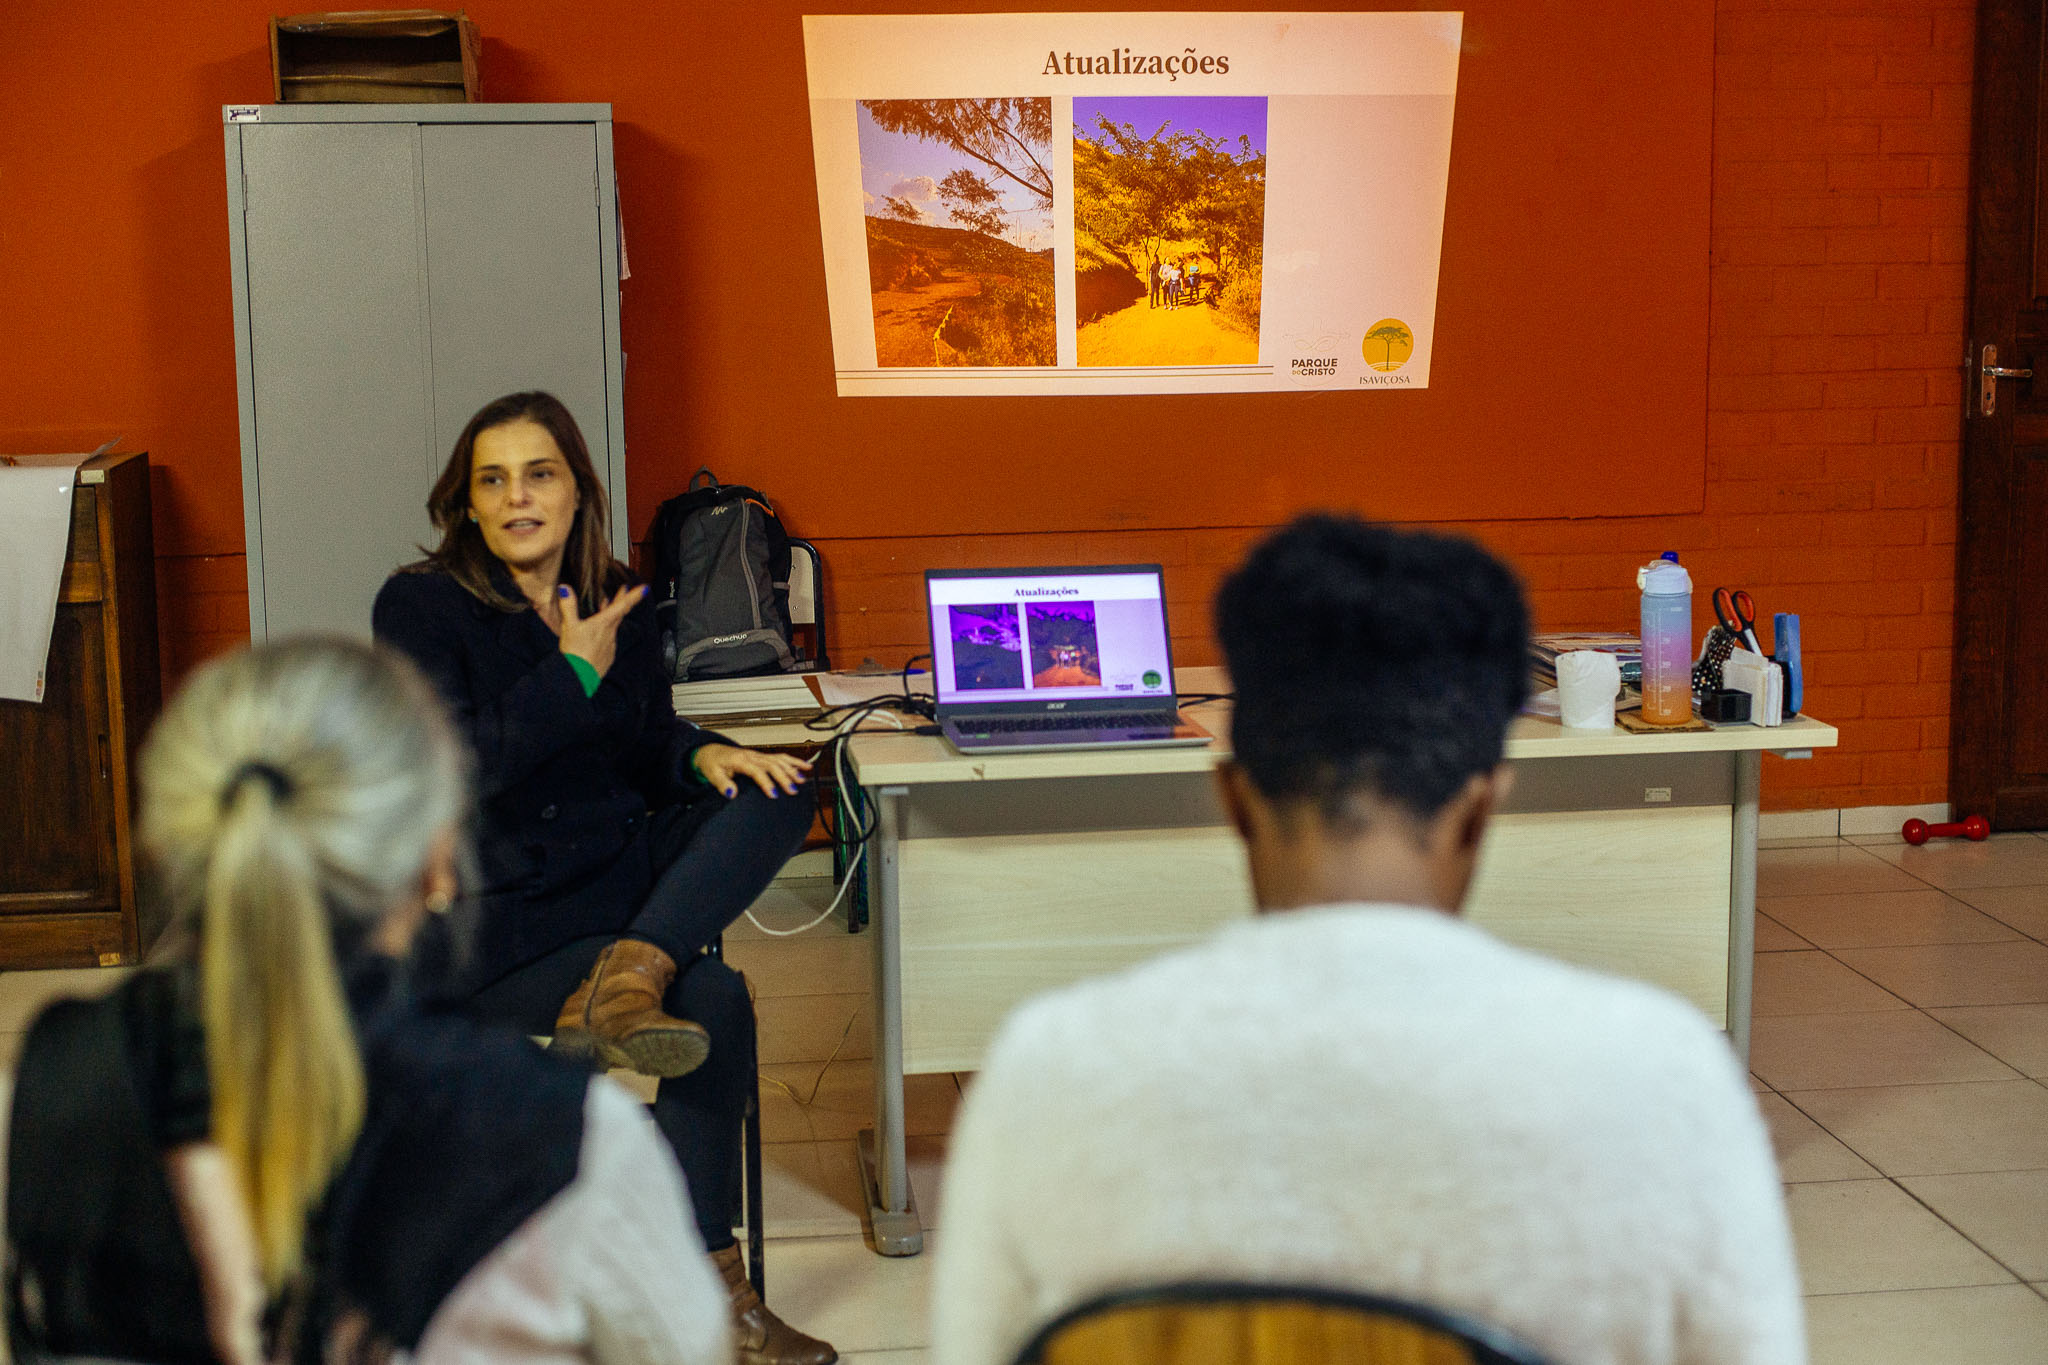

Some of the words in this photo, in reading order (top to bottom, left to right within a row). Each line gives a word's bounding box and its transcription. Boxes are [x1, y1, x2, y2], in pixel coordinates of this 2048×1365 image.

[1041, 47, 1230, 82] Atualizações
[1291, 358, 1338, 368] PARQUE
[1301, 367, 1336, 376] CRISTO
[1359, 375, 1411, 386] ISAVIÇOSA
[1014, 586, 1079, 598] Atualizações
